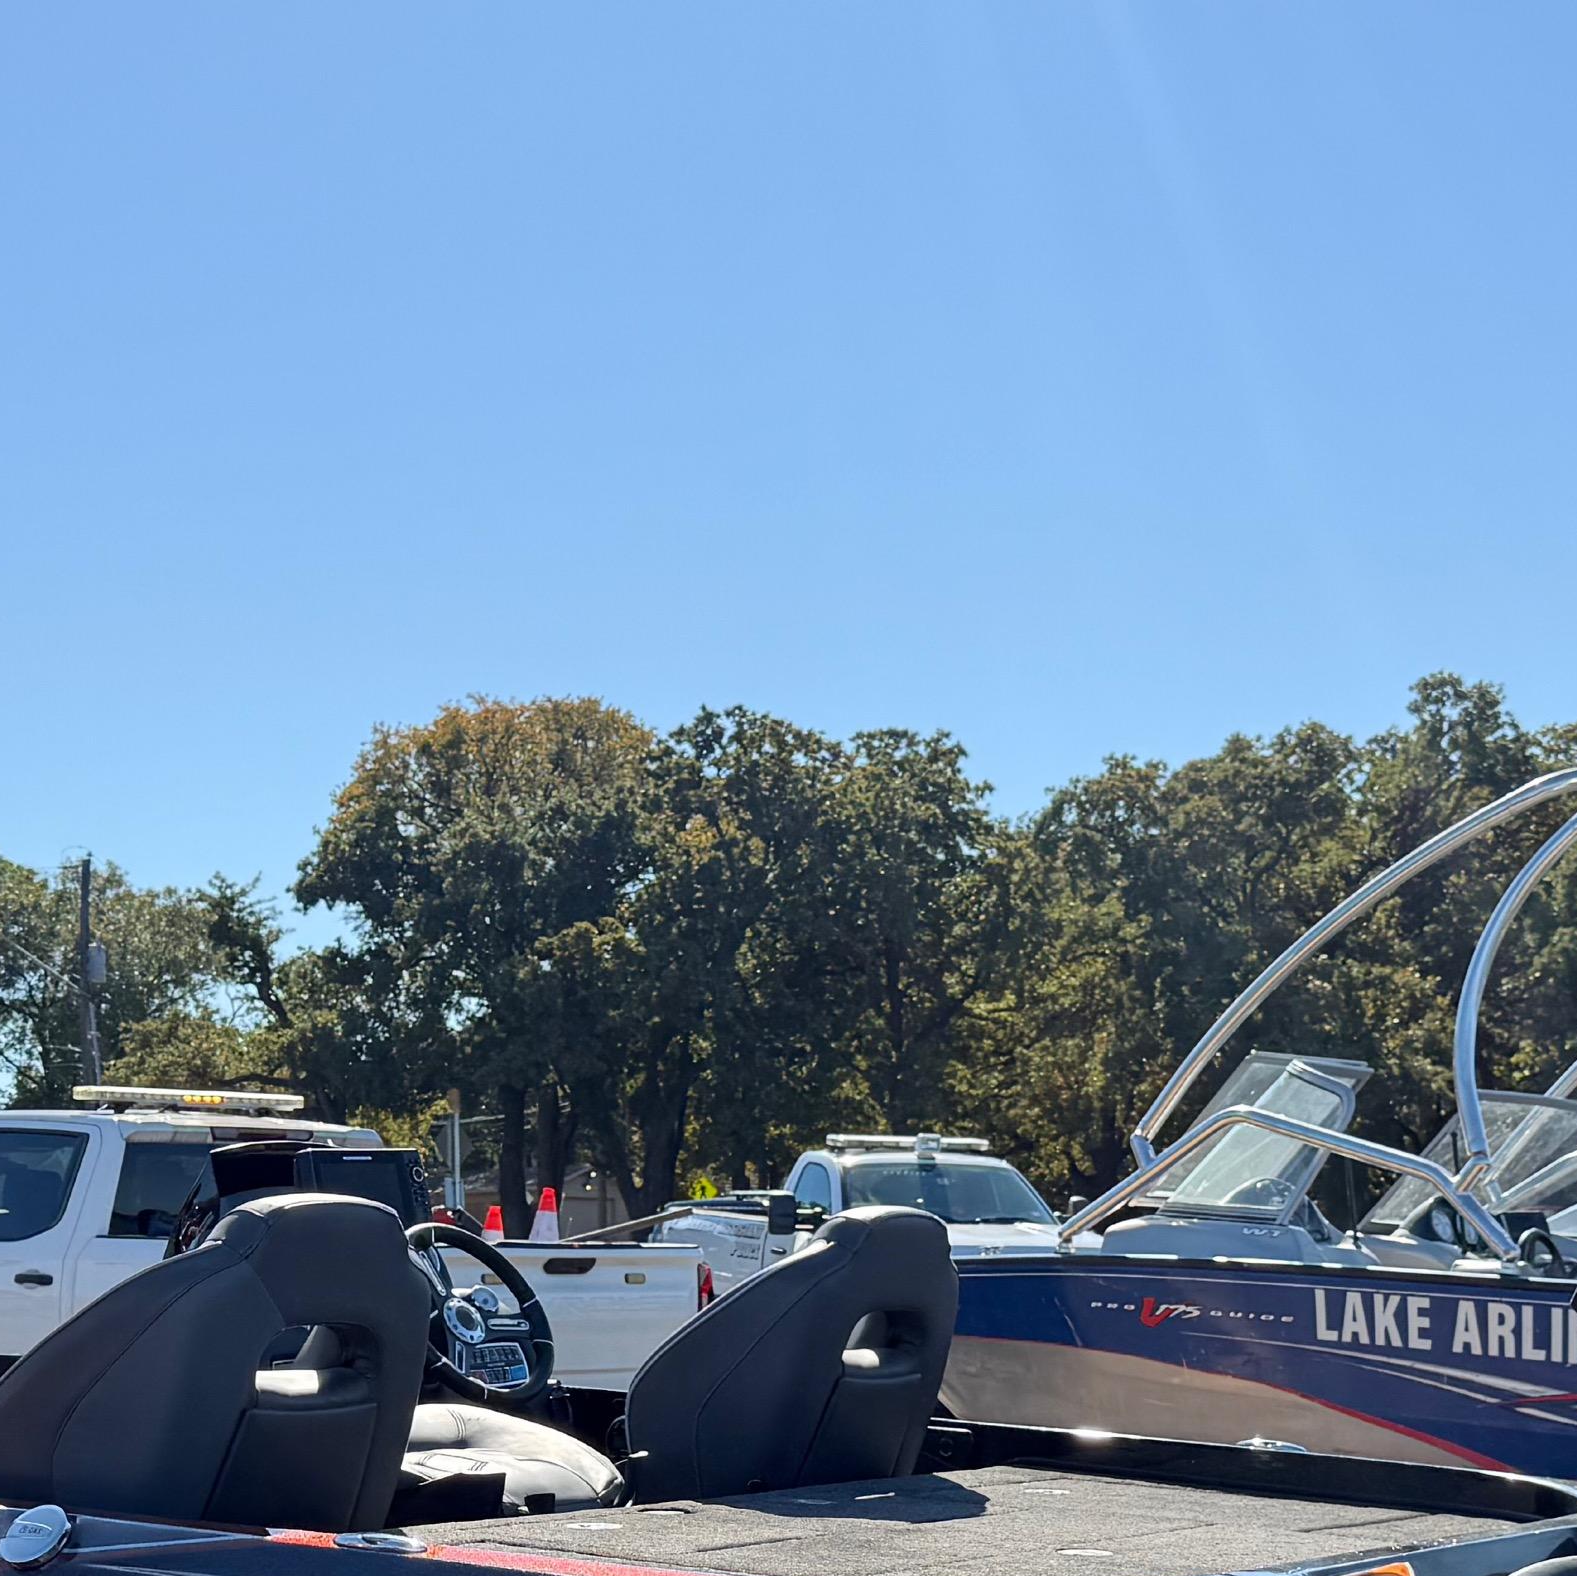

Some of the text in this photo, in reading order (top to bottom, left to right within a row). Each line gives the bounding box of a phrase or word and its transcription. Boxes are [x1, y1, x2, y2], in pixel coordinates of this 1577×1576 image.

[1090, 1302, 1135, 1312] PRO
[1209, 1310, 1295, 1323] GUIDE
[1313, 1288, 1432, 1351] LAKE
